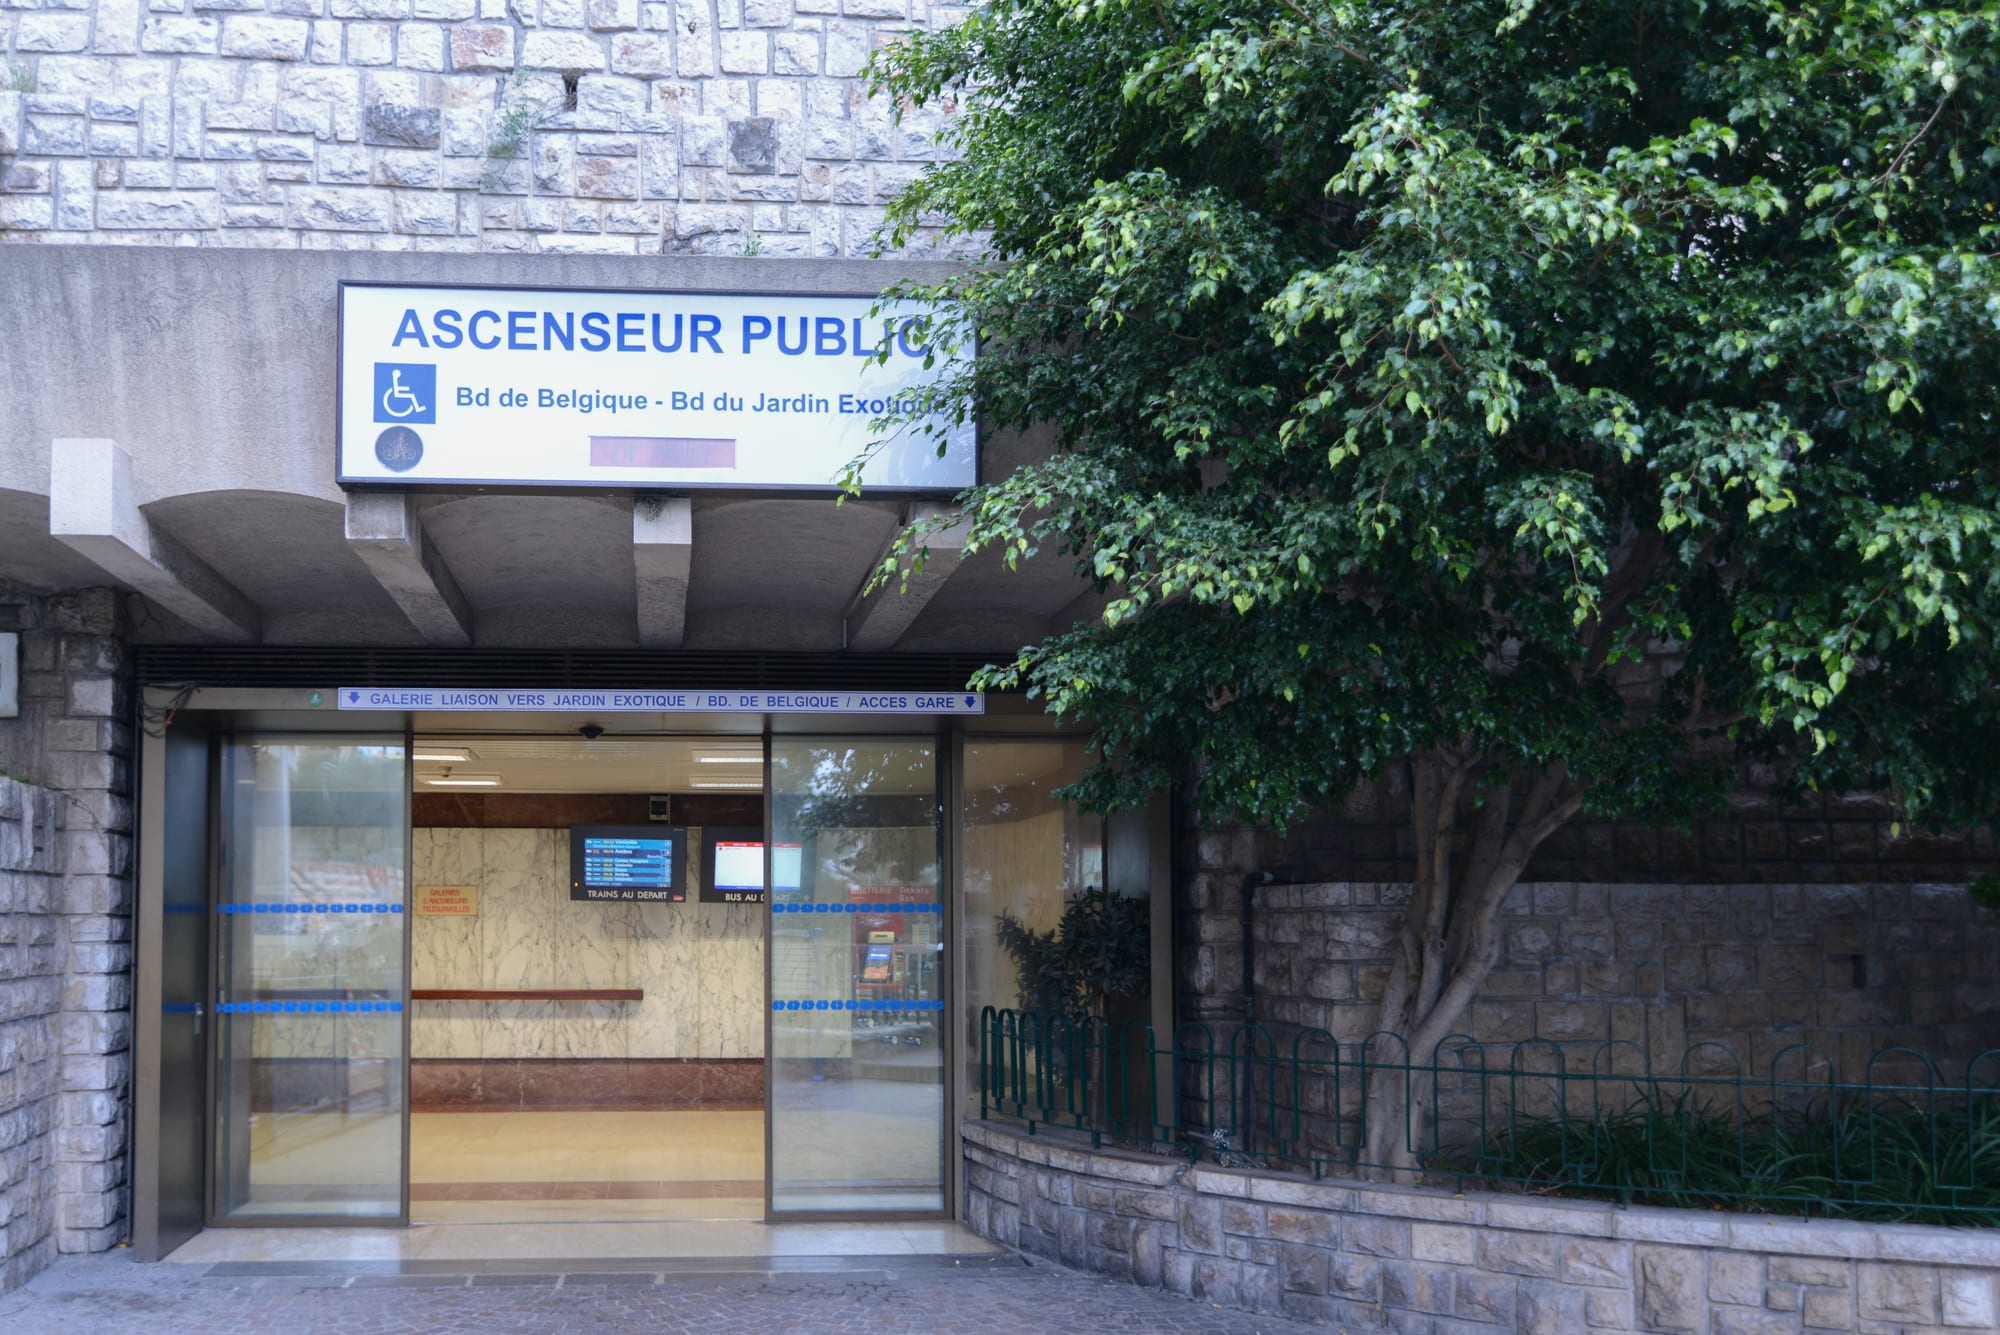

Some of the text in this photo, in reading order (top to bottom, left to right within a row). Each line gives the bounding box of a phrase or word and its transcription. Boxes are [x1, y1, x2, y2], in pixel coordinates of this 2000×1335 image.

[391, 308, 930, 359] ASCENSEUR PUBLIC
[456, 387, 490, 408] Bd
[498, 387, 529, 408] de
[537, 388, 648, 414] Belgique
[671, 391, 705, 411] Bd
[713, 391, 744, 412] du
[751, 393, 829, 414] Jardin
[370, 693, 433, 705] GALERIE
[441, 694, 499, 705] LIAISON
[507, 694, 546, 706] VERS
[553, 694, 606, 706] JARDIN
[613, 695, 686, 707] EXOTIQUE
[707, 695, 732, 707] BD.
[739, 696, 759, 707] DE
[767, 696, 839, 708] BELGIQUE
[859, 697, 907, 708] ACCES
[915, 697, 955, 708] GARE
[587, 890, 618, 898] TRAINS
[621, 891, 634, 899] AU
[637, 891, 668, 899] DEPART
[725, 893, 742, 901] BUS
